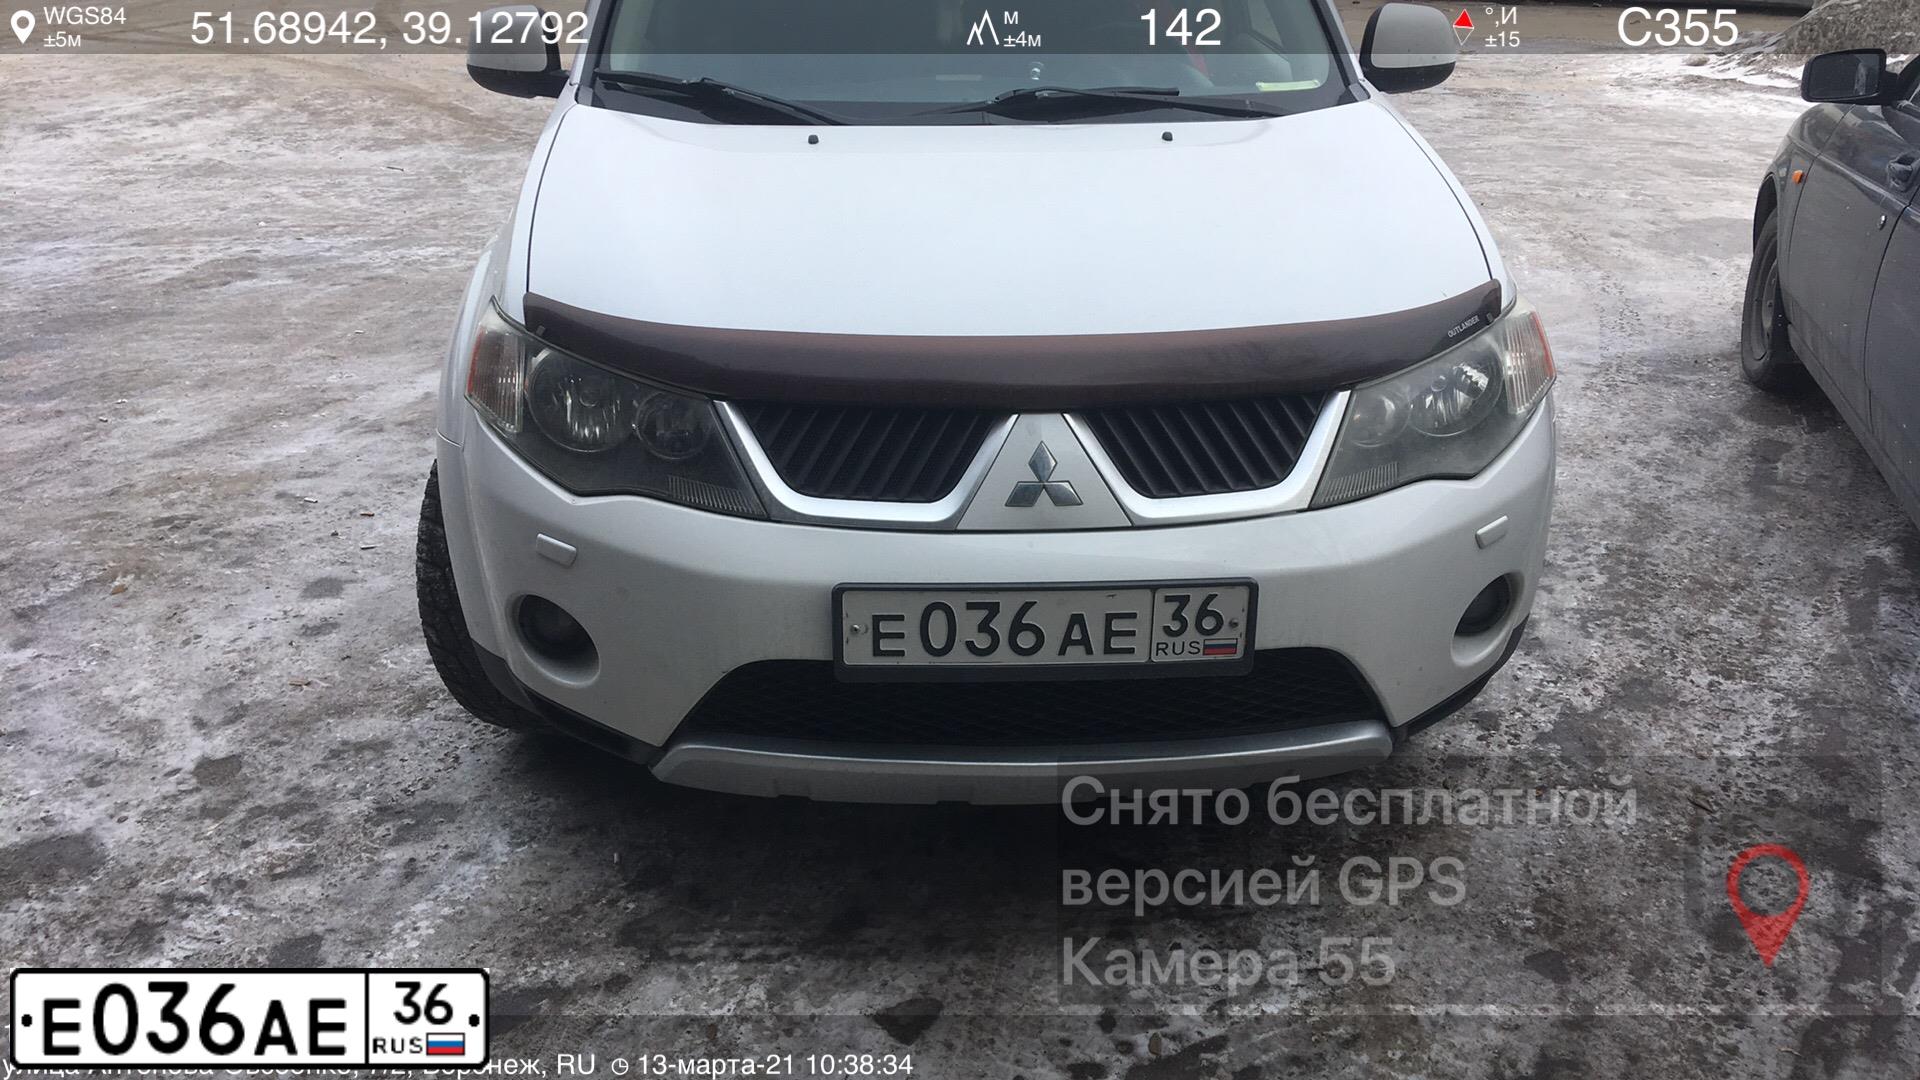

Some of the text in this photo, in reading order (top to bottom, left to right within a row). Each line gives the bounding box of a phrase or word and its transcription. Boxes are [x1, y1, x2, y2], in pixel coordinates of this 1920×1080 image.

[1447, 314, 1480, 338] OUTLANDER
[1162, 593, 1225, 638] 36
[1155, 641, 1201, 656] RUS
